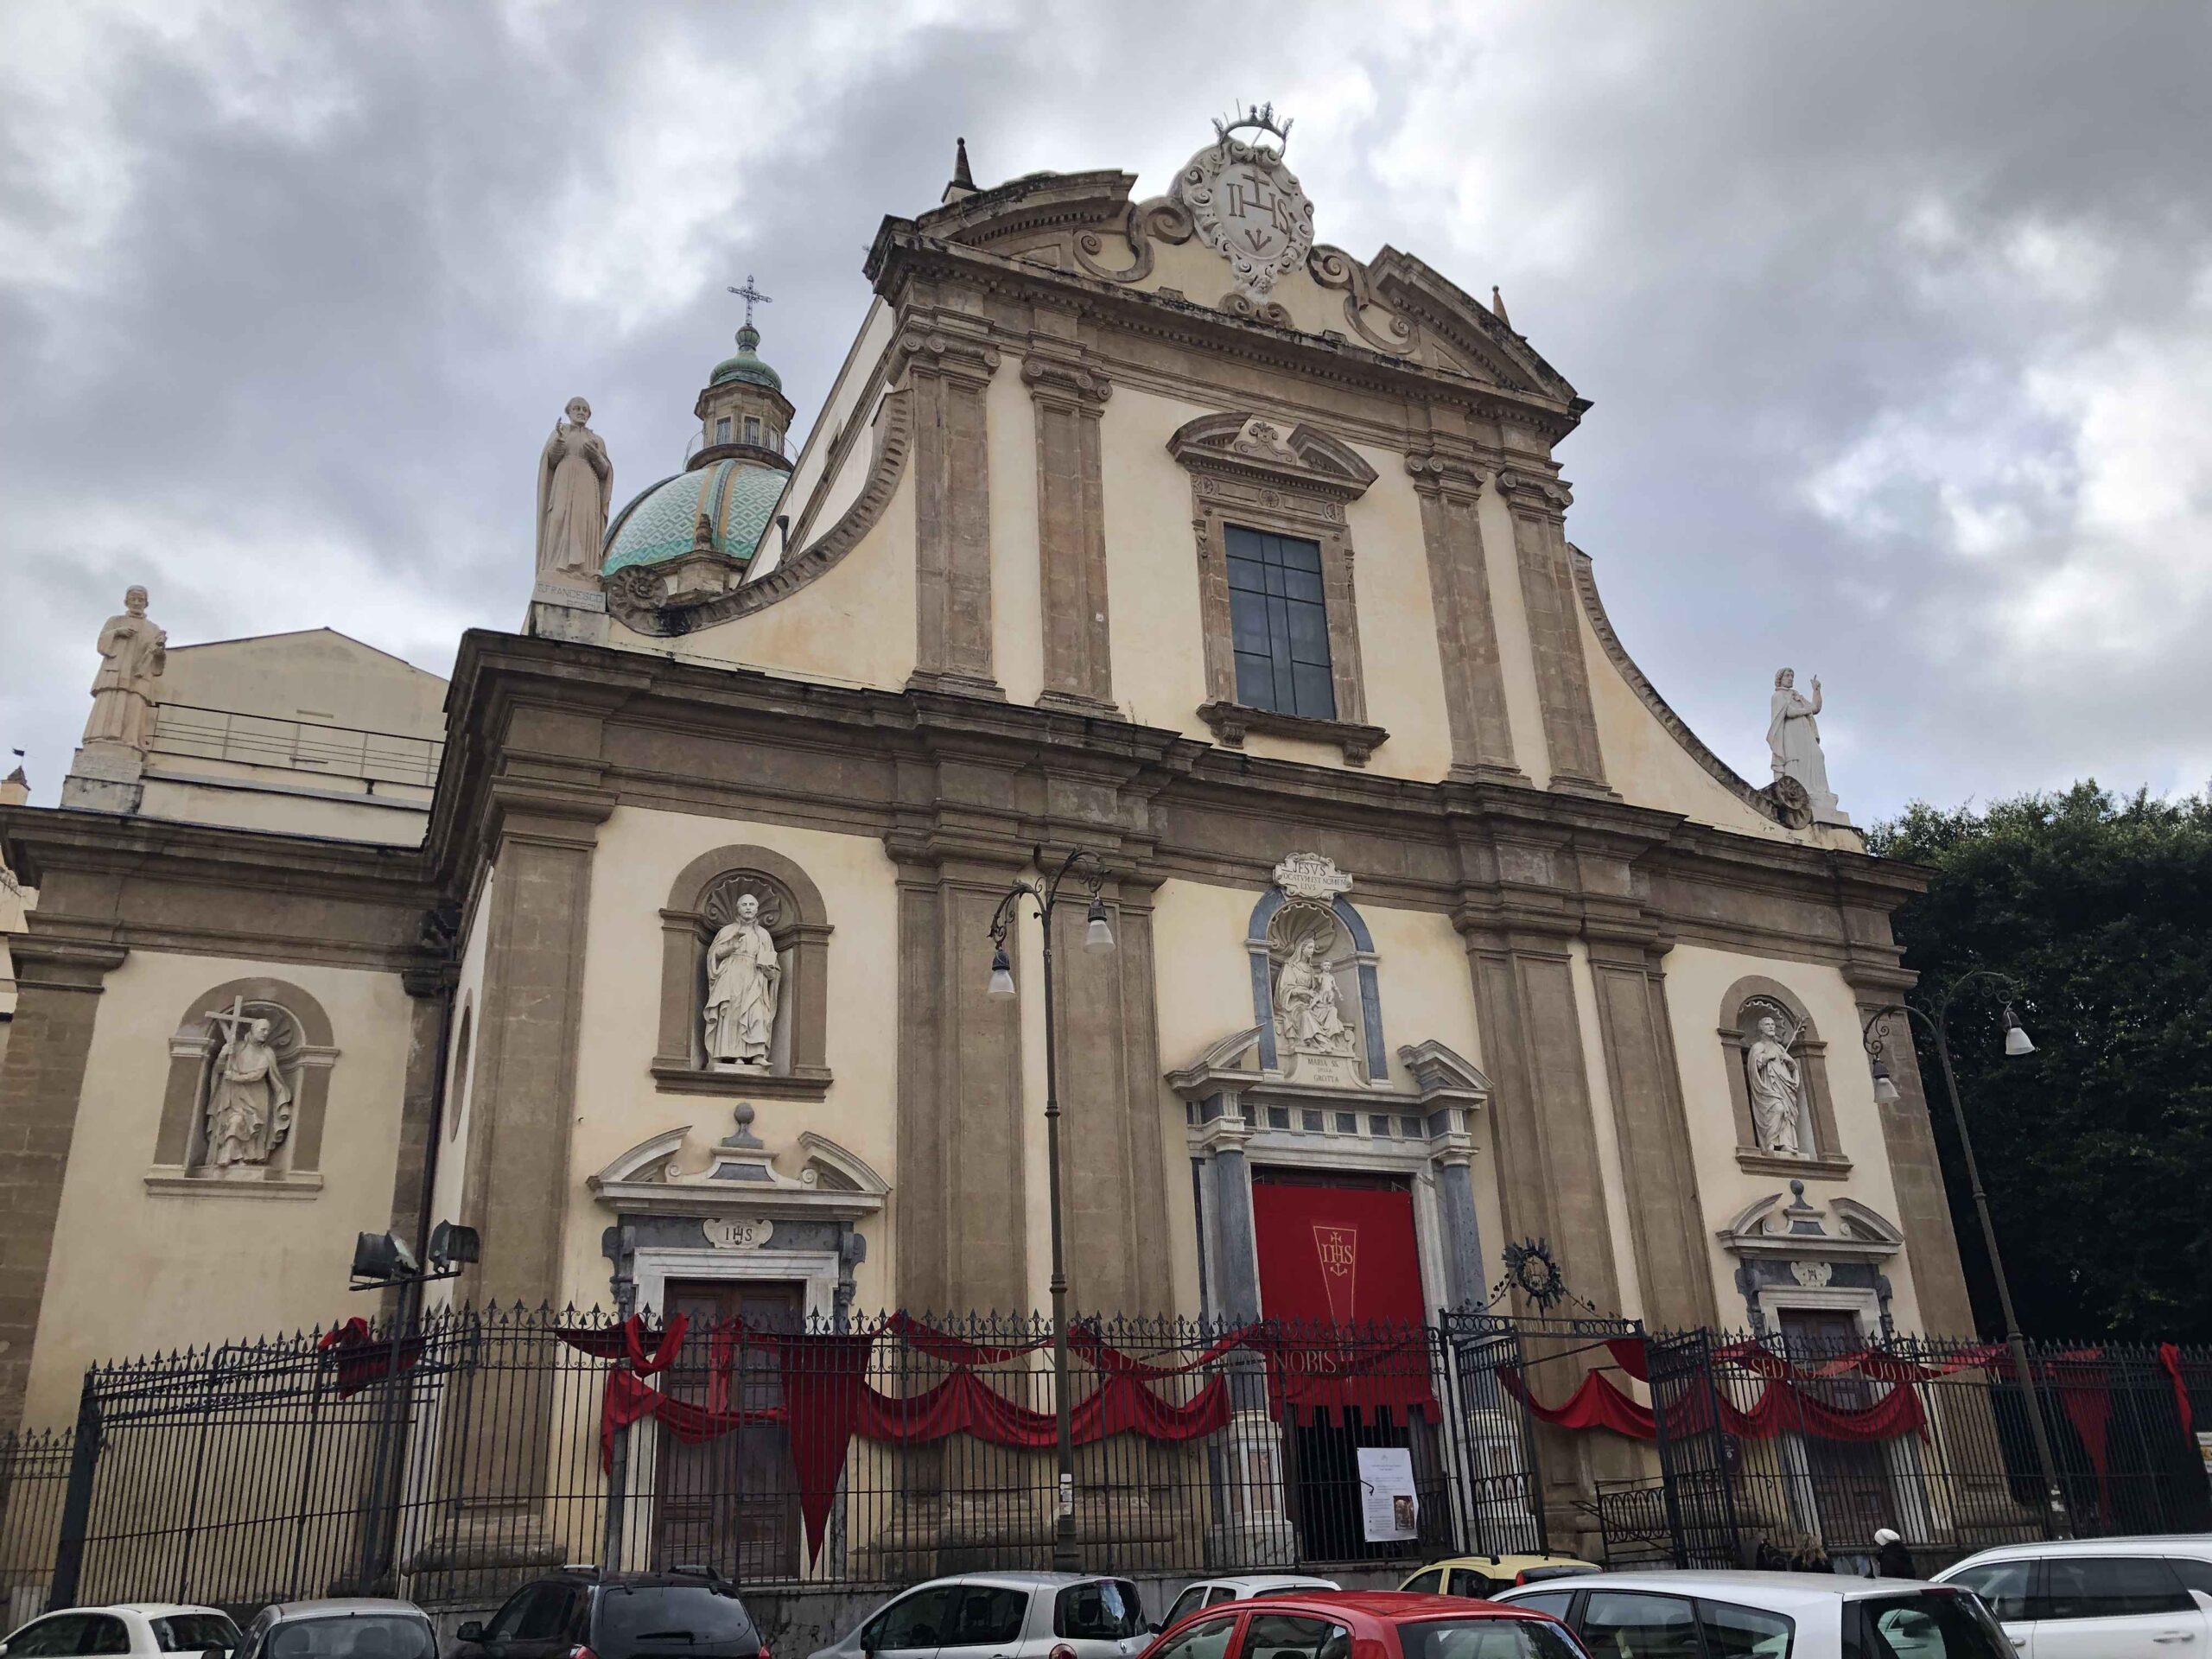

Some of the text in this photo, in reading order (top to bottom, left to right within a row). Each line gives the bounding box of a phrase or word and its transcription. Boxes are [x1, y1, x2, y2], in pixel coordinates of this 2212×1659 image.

[1226, 181, 1290, 235] IHS
[1307, 1057, 1328, 1066] MARIA
[1313, 1074, 1339, 1084] GROTTA
[725, 1226, 753, 1243] IHS
[1322, 1243, 1353, 1265] IHS
[1273, 1350, 1338, 1374] NOBIS
